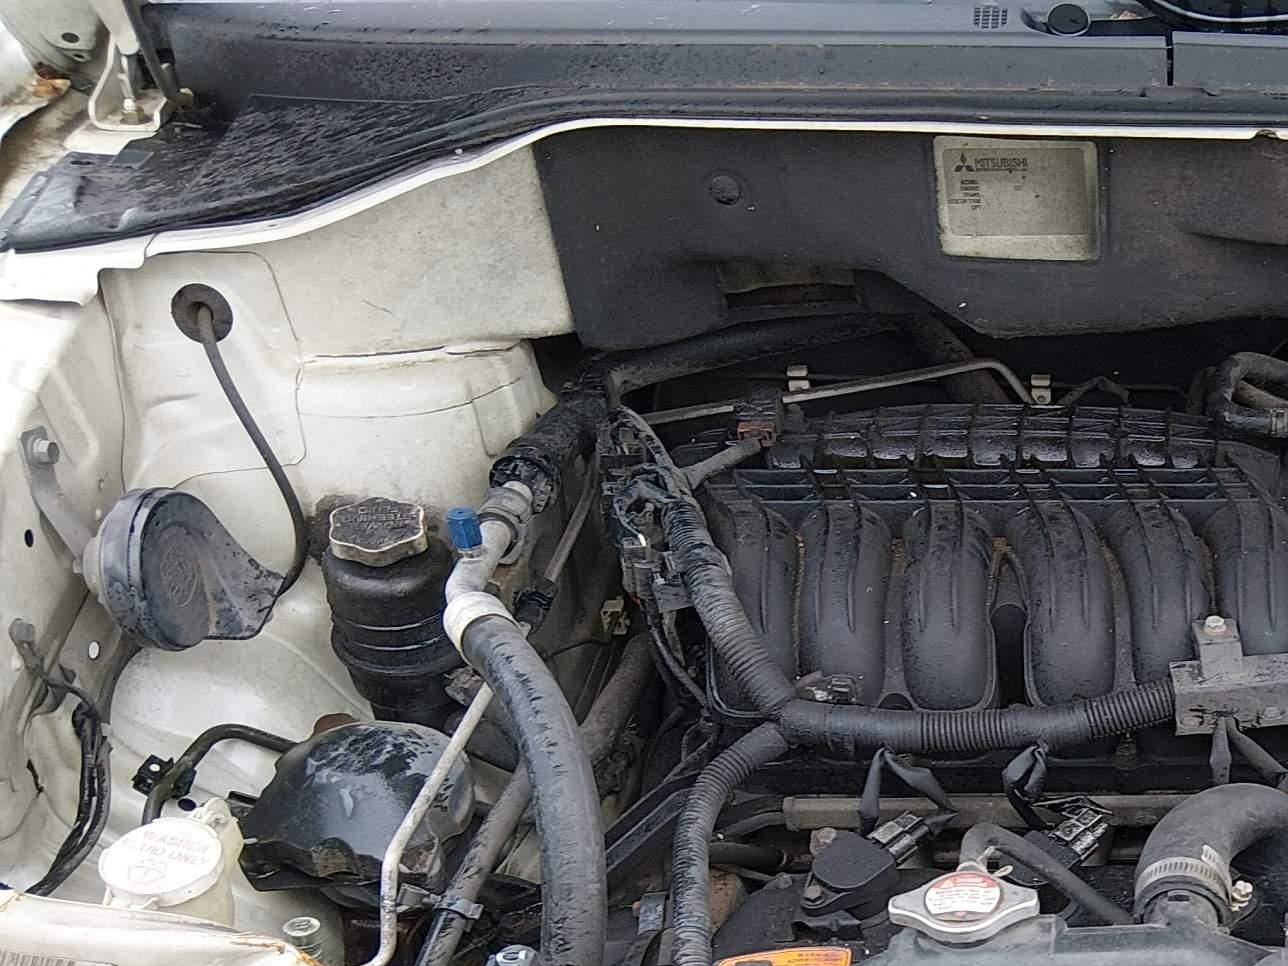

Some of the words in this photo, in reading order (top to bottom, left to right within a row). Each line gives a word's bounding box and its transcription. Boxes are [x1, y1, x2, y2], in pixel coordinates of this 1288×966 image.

[974, 158, 1028, 168] MITSUBISHI
[144, 830, 210, 853] WASHER
[169, 849, 210, 865] ONLY
